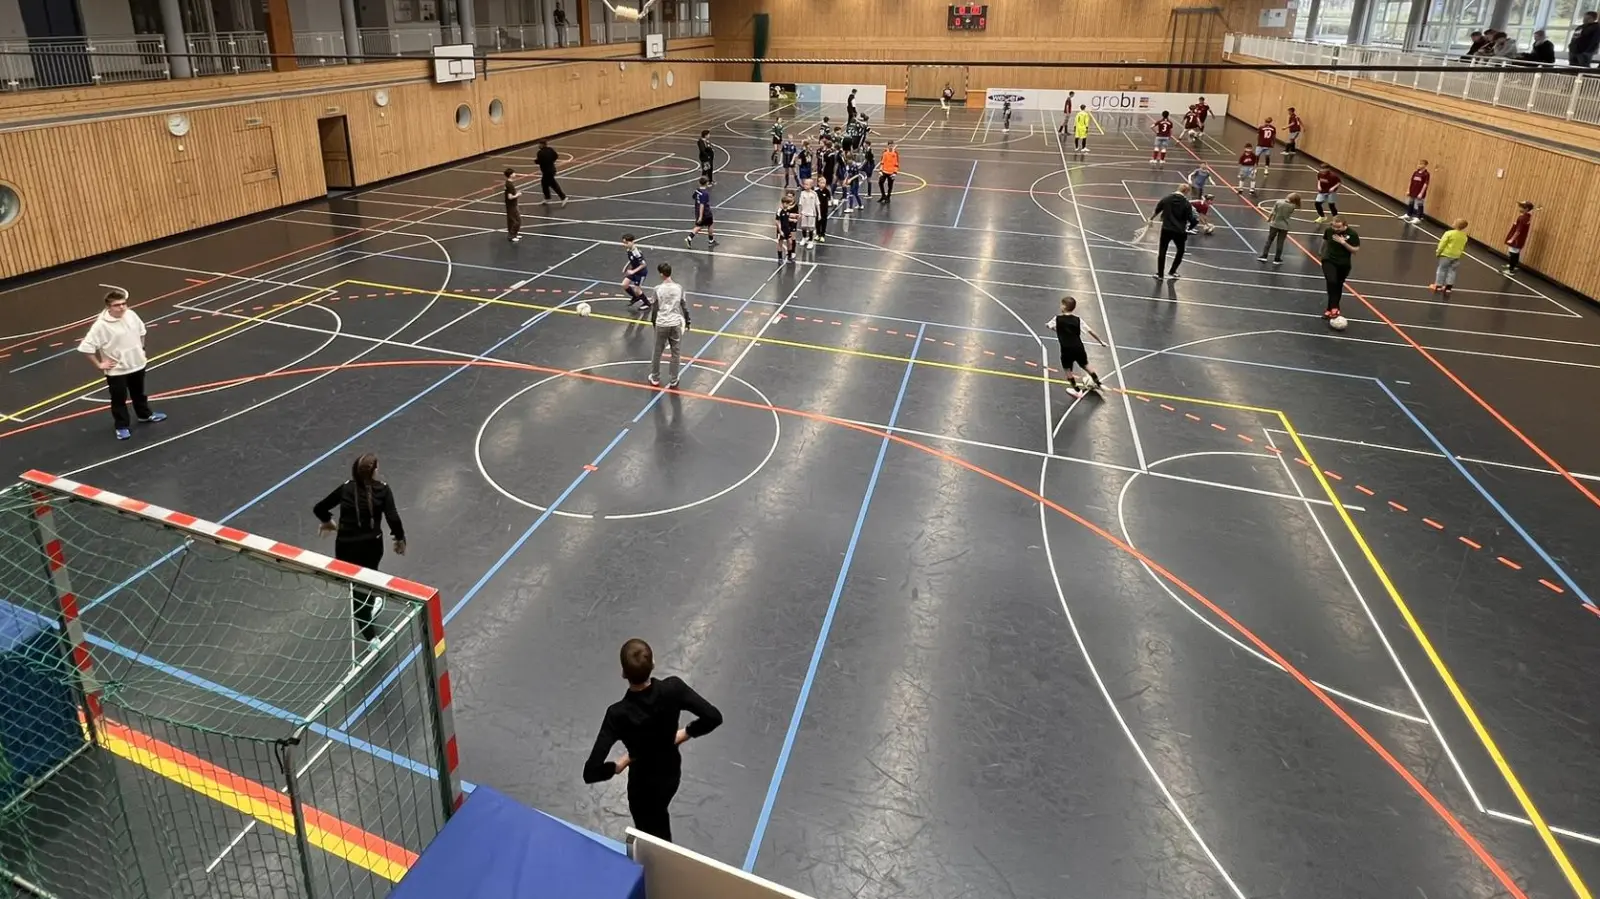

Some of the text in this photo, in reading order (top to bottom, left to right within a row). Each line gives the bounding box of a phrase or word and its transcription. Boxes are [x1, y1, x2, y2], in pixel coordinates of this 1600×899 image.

[1091, 92, 1136, 110] grobi
[1161, 124, 1168, 132] 3
[1263, 130, 1272, 139] 10
